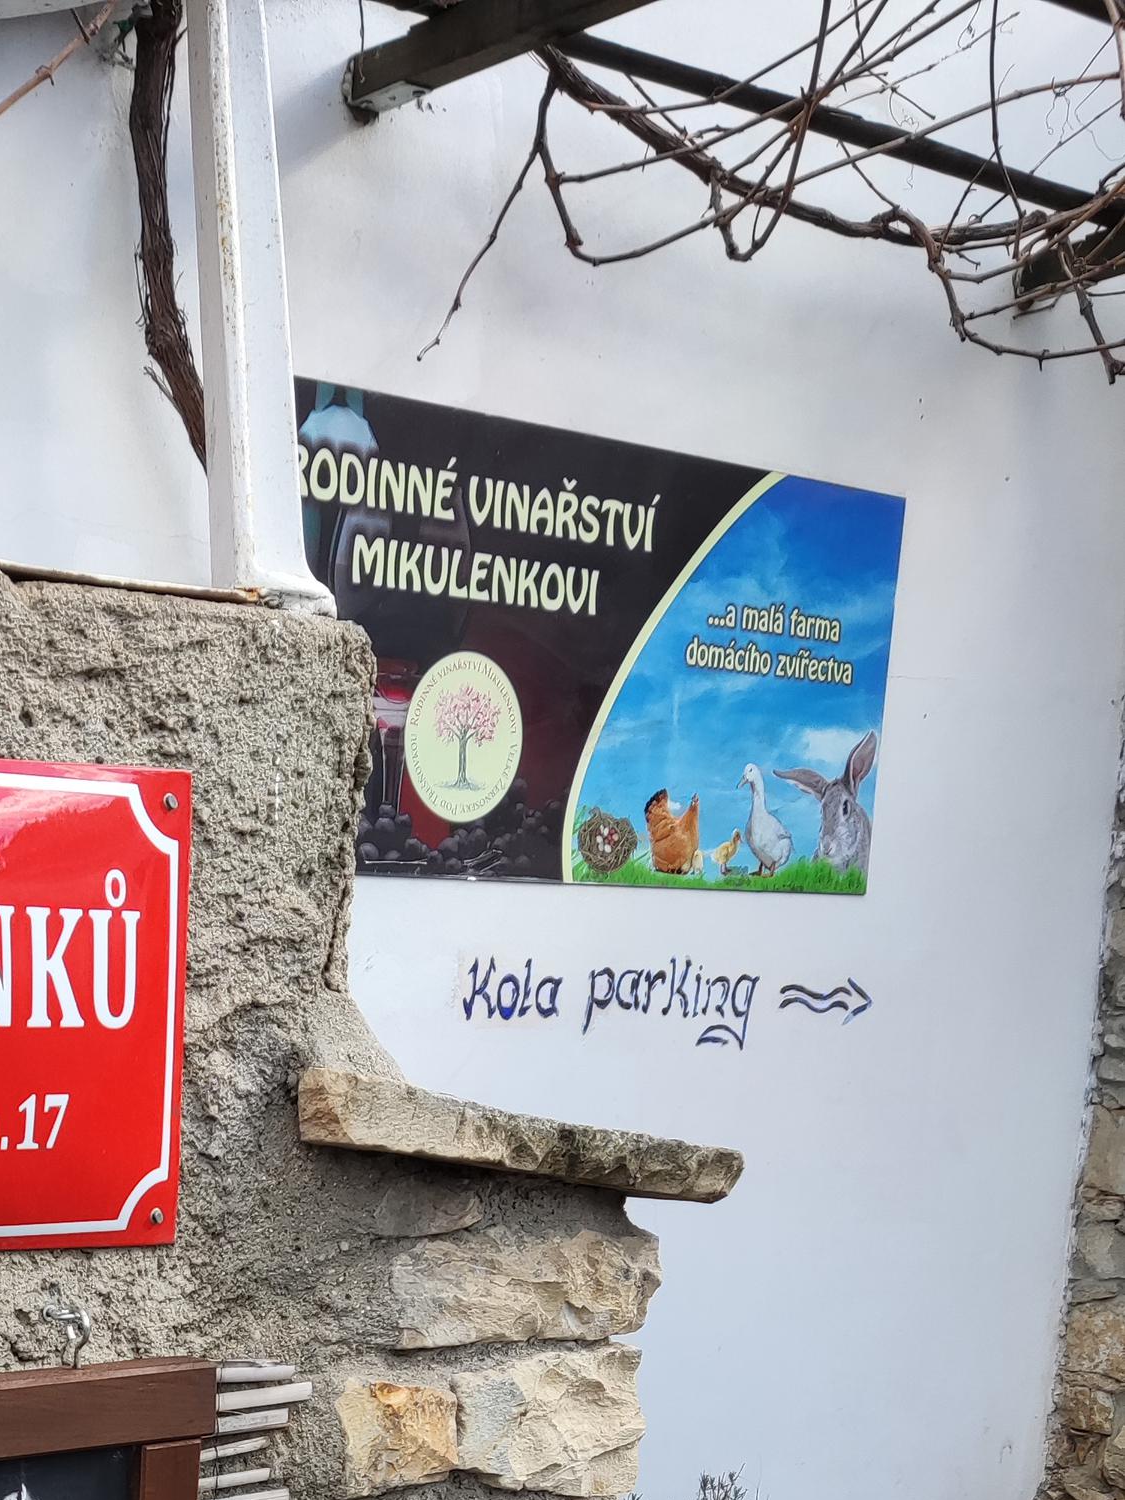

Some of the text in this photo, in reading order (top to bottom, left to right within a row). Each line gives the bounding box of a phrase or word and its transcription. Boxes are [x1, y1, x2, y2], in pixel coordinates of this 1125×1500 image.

[468, 475, 661, 553] VINAŘSTVÍ
[352, 533, 600, 616] MIKULENKOVI
[742, 604, 785, 635] malá
[790, 608, 841, 642] farma
[686, 636, 853, 686] domácího zvířectva
[462, 956, 563, 1021] Kola
